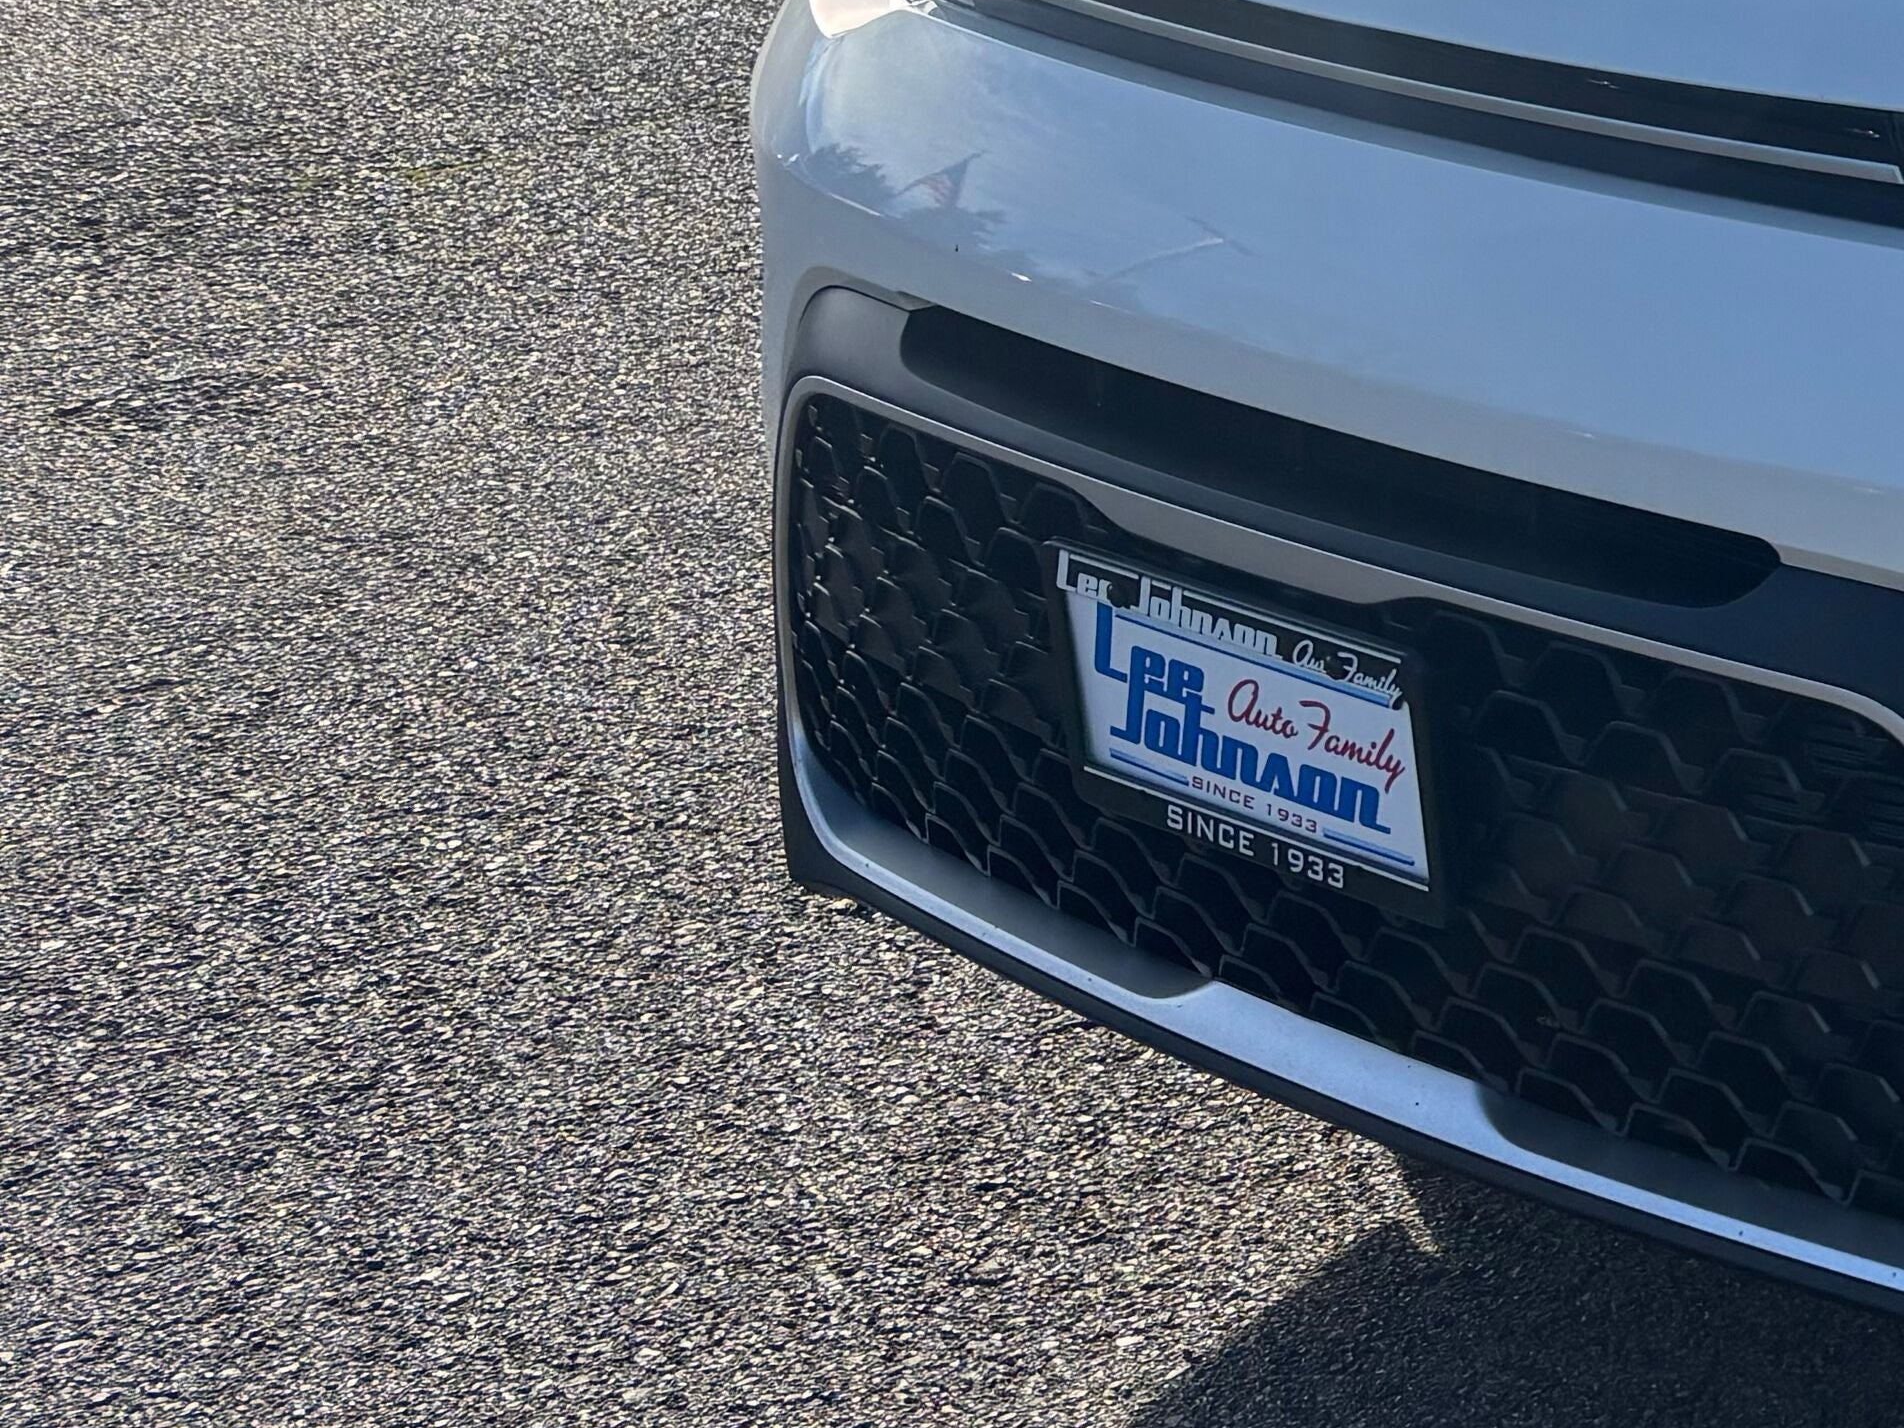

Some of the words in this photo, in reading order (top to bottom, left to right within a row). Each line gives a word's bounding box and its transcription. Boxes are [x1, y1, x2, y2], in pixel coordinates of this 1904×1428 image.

[1094, 601, 1215, 715] Lee
[1130, 575, 1284, 662] Johnson
[1336, 651, 1403, 709] Family
[1110, 682, 1392, 835] Johnson
[1227, 679, 1299, 739] Auto
[1298, 700, 1406, 794] Family
[1166, 804, 1255, 858] SINCE
[1271, 842, 1345, 889] 1933
[1191, 775, 1256, 810] SINCE
[1266, 803, 1318, 834] 1933
